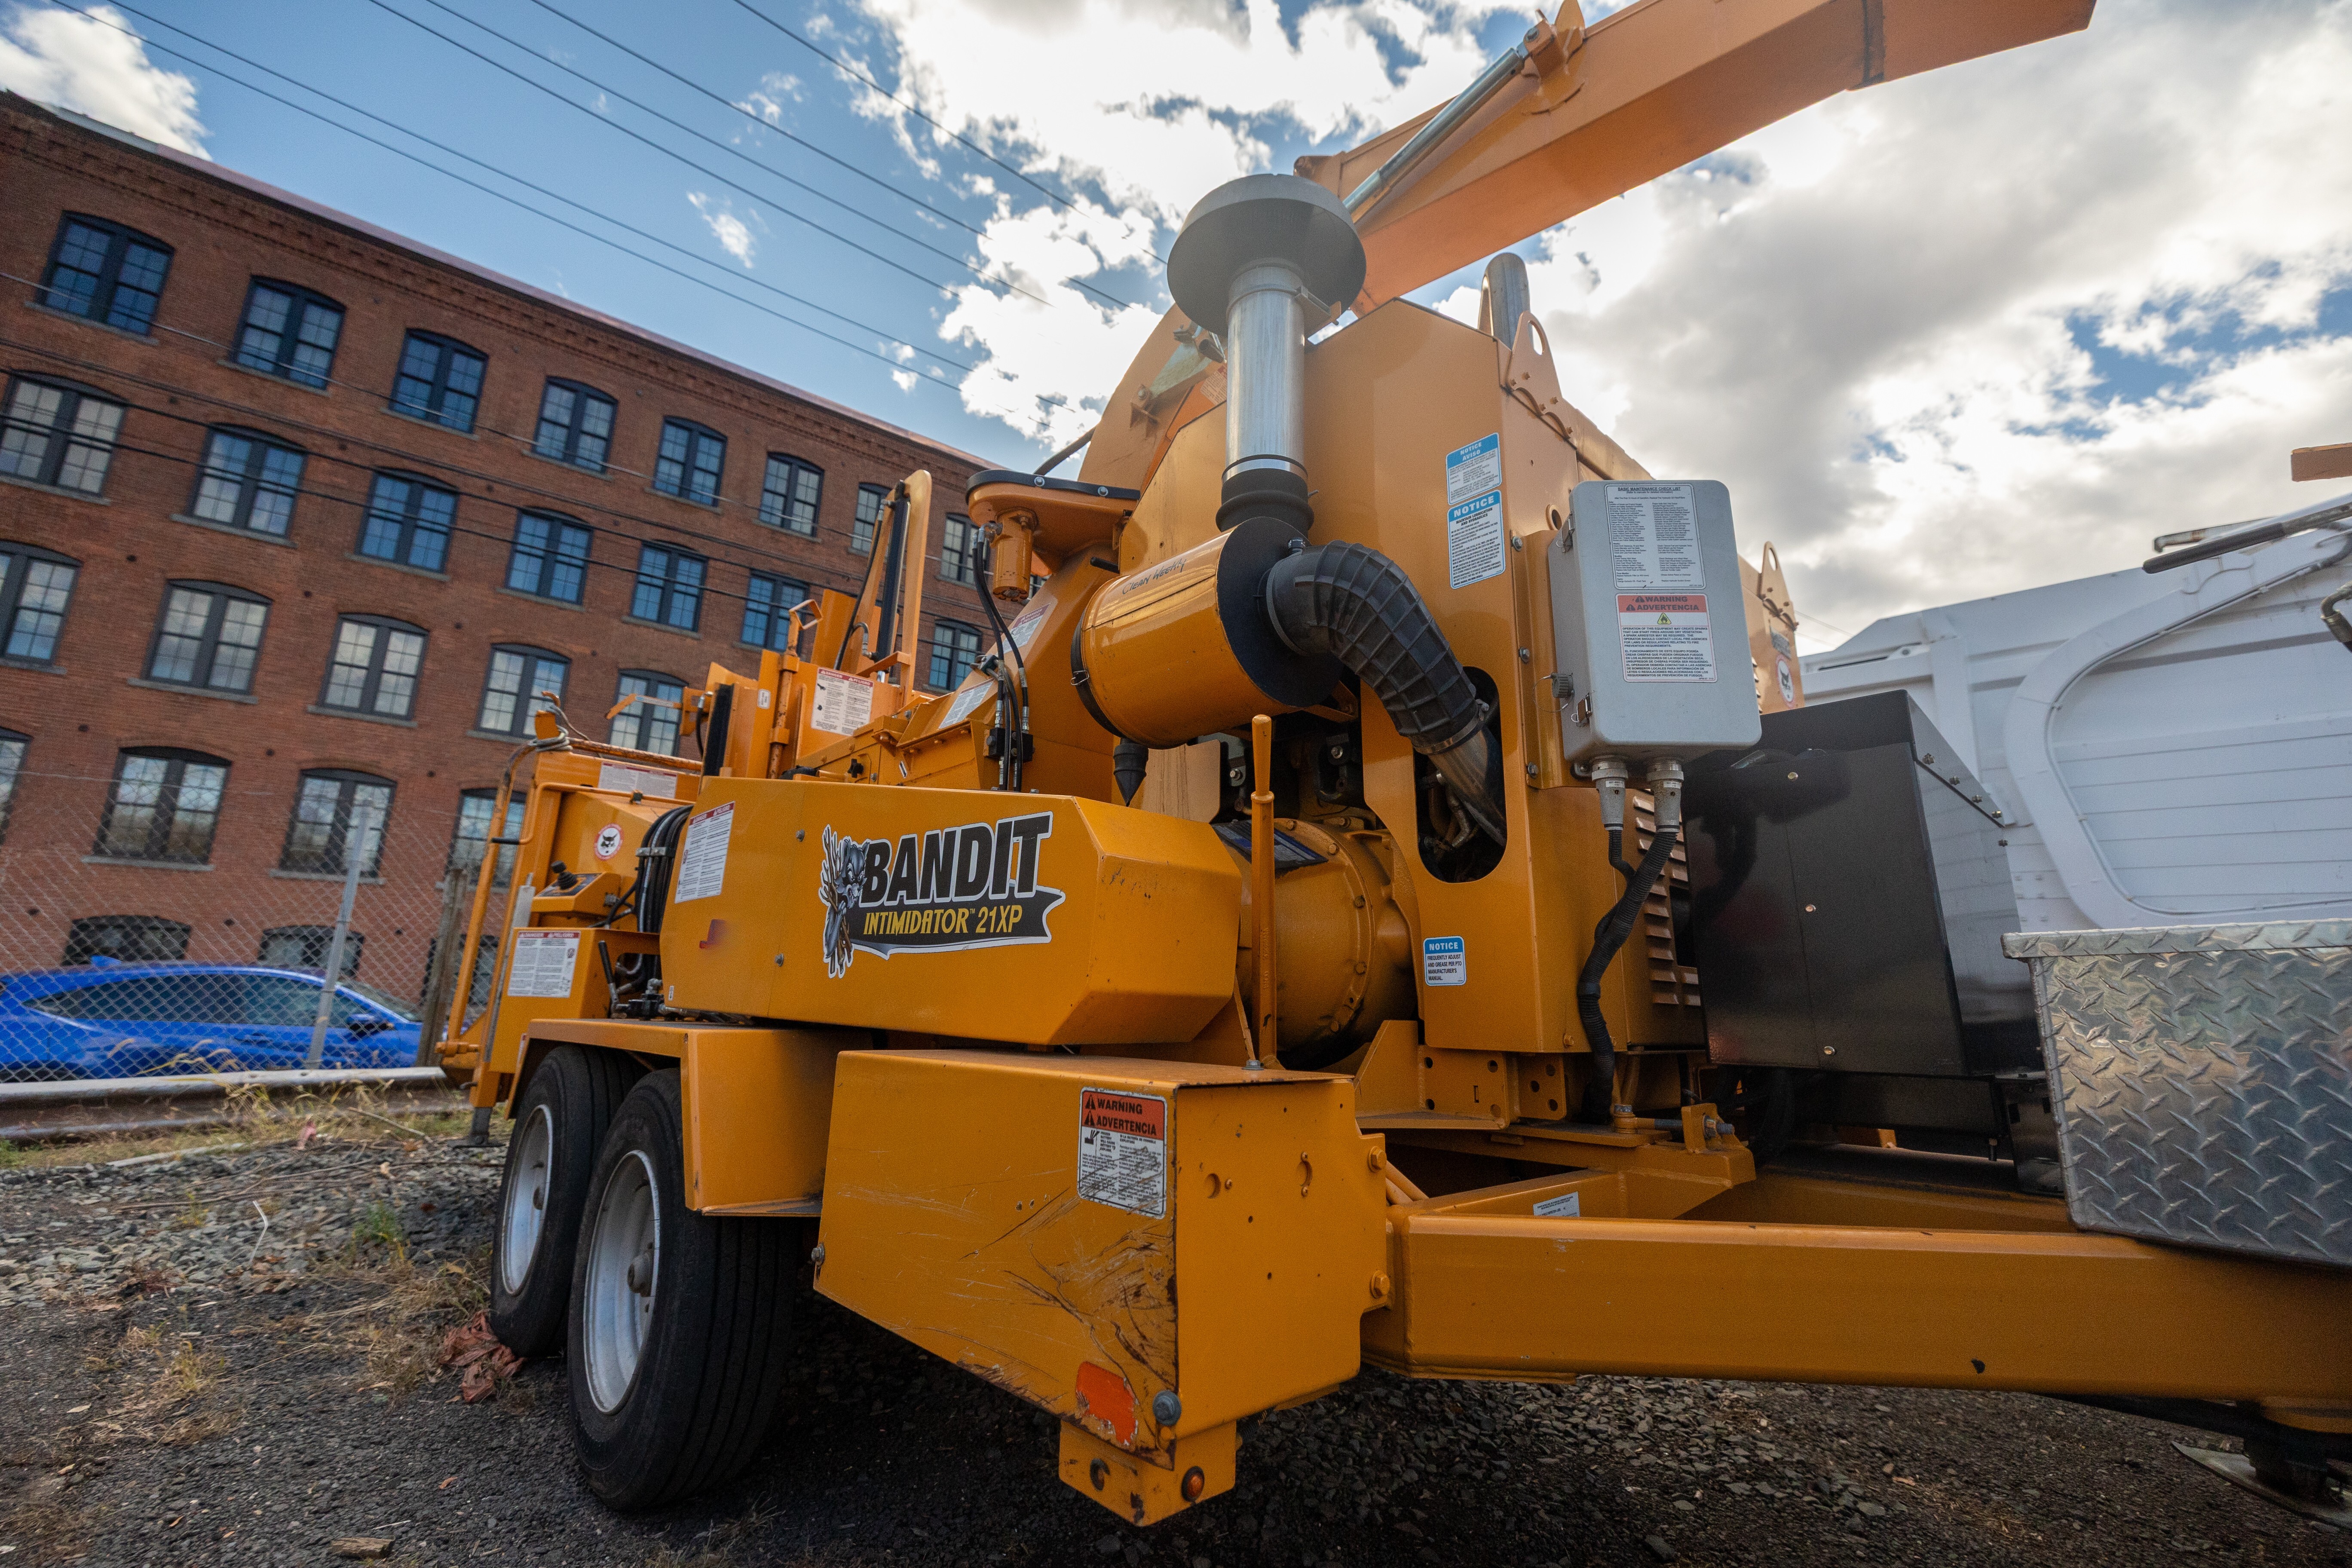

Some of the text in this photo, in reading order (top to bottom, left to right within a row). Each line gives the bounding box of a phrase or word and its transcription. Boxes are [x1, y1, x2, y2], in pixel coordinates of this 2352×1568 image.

[1460, 441, 1482, 455] NOTICE
[1462, 449, 1480, 461] AVISO
[1454, 495, 1494, 518] NOTICE
[1456, 507, 1492, 524] MAINTAIN LUBRICATION
[1468, 513, 1488, 523] HYDRAULICS
[861, 815, 1050, 904] BANDIT
[976, 905, 1023, 933] 21XP
[1429, 942, 1458, 950] NOTICE
[1097, 1098, 1142, 1115] WARNING
[1096, 1115, 1157, 1136] ADVERTENCIA
